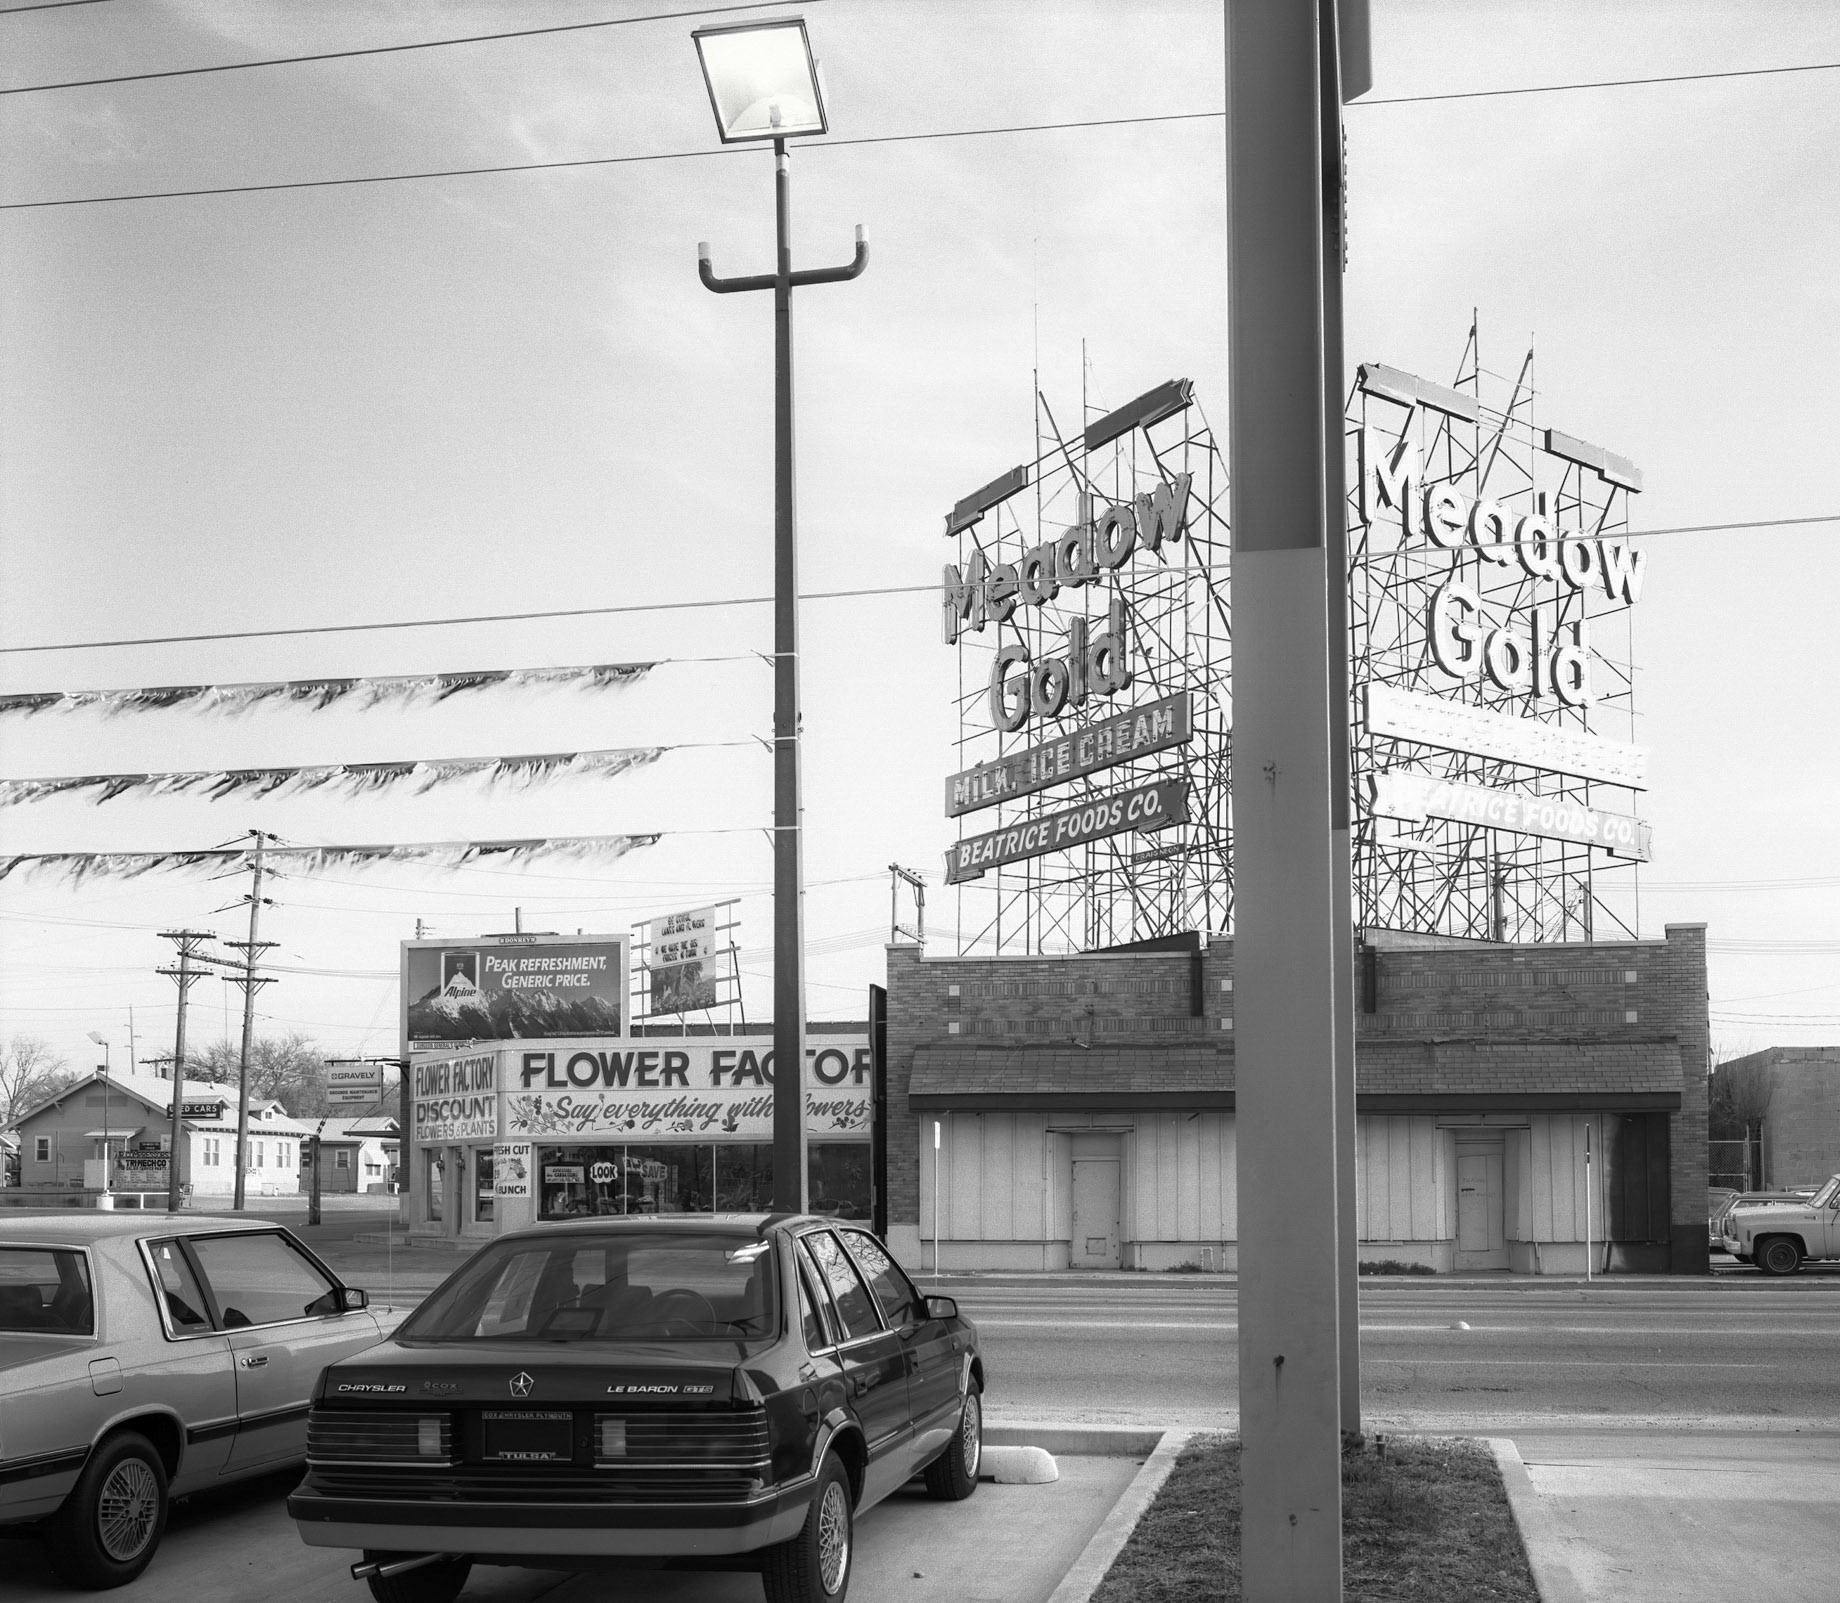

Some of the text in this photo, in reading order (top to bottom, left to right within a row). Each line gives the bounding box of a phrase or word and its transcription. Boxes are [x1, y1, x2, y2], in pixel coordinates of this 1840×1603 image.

[1358, 425, 1648, 605] Meadow
[942, 472, 1192, 645] Meadow
[1428, 580, 1596, 709] Gold
[989, 598, 1132, 732] Gold
[1030, 741, 1070, 784] ICE
[1079, 705, 1175, 767] CREAM
[959, 790, 1163, 868] BEATRICE FOODS CO.
[1524, 803, 1599, 838] FOODS
[1602, 819, 1635, 845] CO.
[485, 956, 607, 972] PEAK REFRESHMENT,
[501, 972, 591, 988] GENERIC PRICE.
[444, 986, 477, 999] Alpine
[338, 1071, 375, 1079] GRAVELY
[416, 1055, 494, 1097] FLOWER FACTORY
[520, 1051, 690, 1088] FLOWER
[194, 1104, 217, 1113] CARS
[416, 1095, 496, 1123] DISCOUNT
[553, 1094, 774, 1132] Say everything with
[806, 1093, 866, 1117] owers
[416, 1123, 454, 1139] FLOWERS
[461, 1120, 495, 1136] PLANTS
[512, 1145, 530, 1155] CUT
[592, 1165, 616, 1179] LOOK
[641, 1164, 666, 1179] SAVE
[338, 1384, 406, 1392] CHRYSLER
[607, 1385, 625, 1393] LE
[627, 1385, 679, 1393] BARON
[505, 1452, 550, 1460] TULSA
